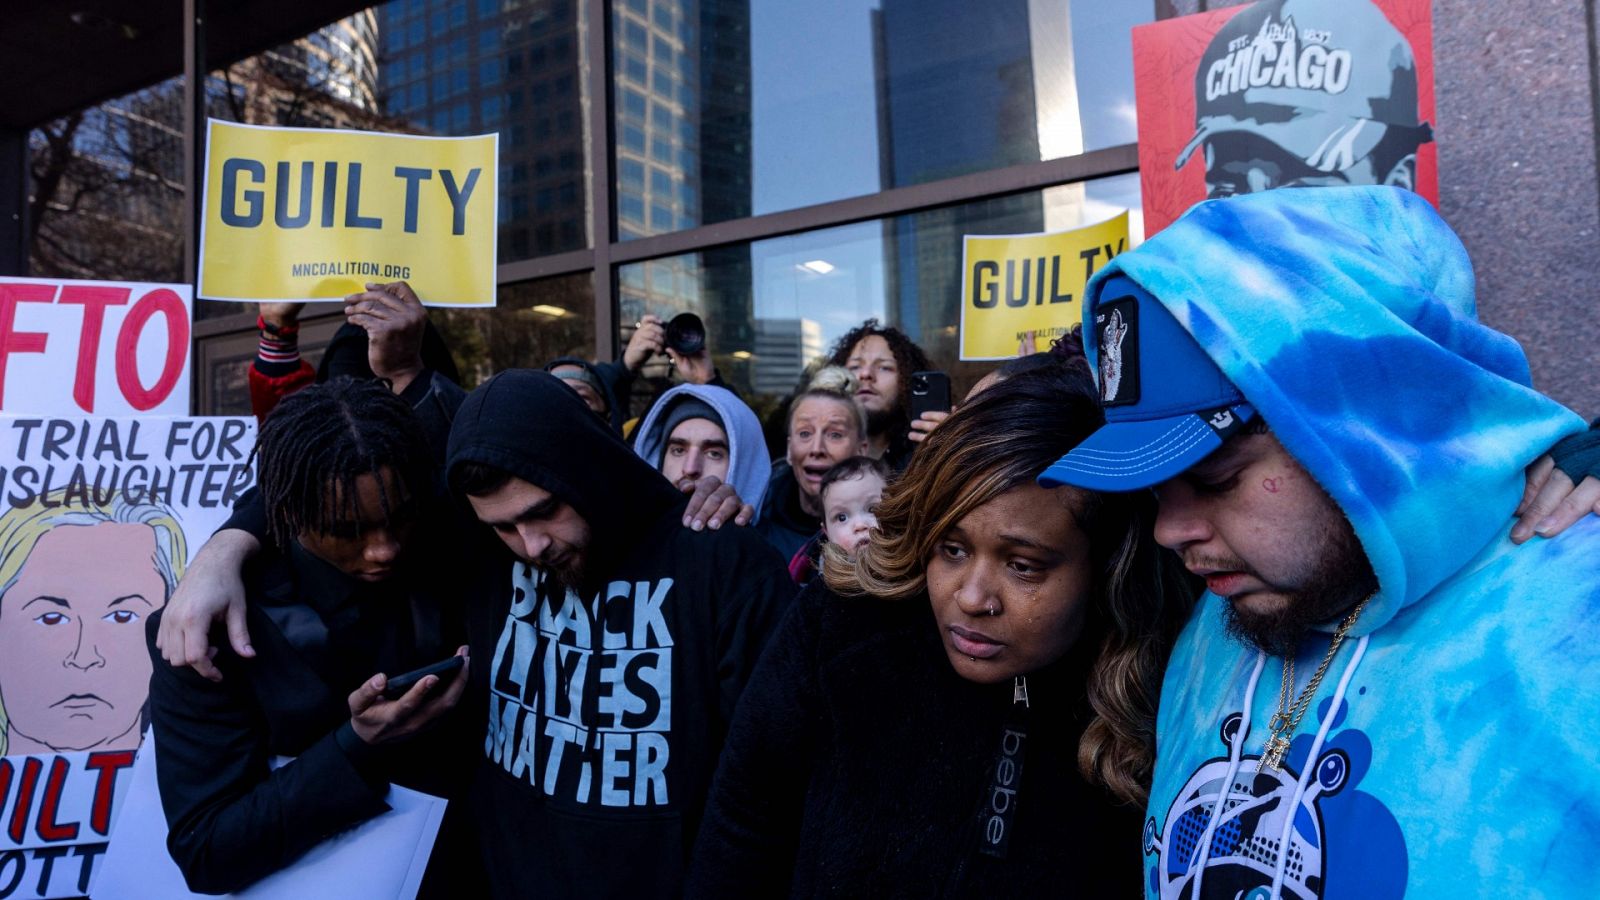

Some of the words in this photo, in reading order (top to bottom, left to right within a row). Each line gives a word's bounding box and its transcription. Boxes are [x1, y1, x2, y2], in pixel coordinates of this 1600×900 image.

[1206, 42, 1351, 101] CHICAGO
[220, 157, 482, 236] GUILTY
[292, 261, 411, 280] MNCOALITION.ORG
[0, 282, 190, 414] FTO
[12, 419, 149, 462] TRIAL
[165, 419, 246, 462] FOR
[493, 616, 664, 730] LIVES
[484, 690, 670, 808] MATTER
[986, 729, 1026, 845] bebe
